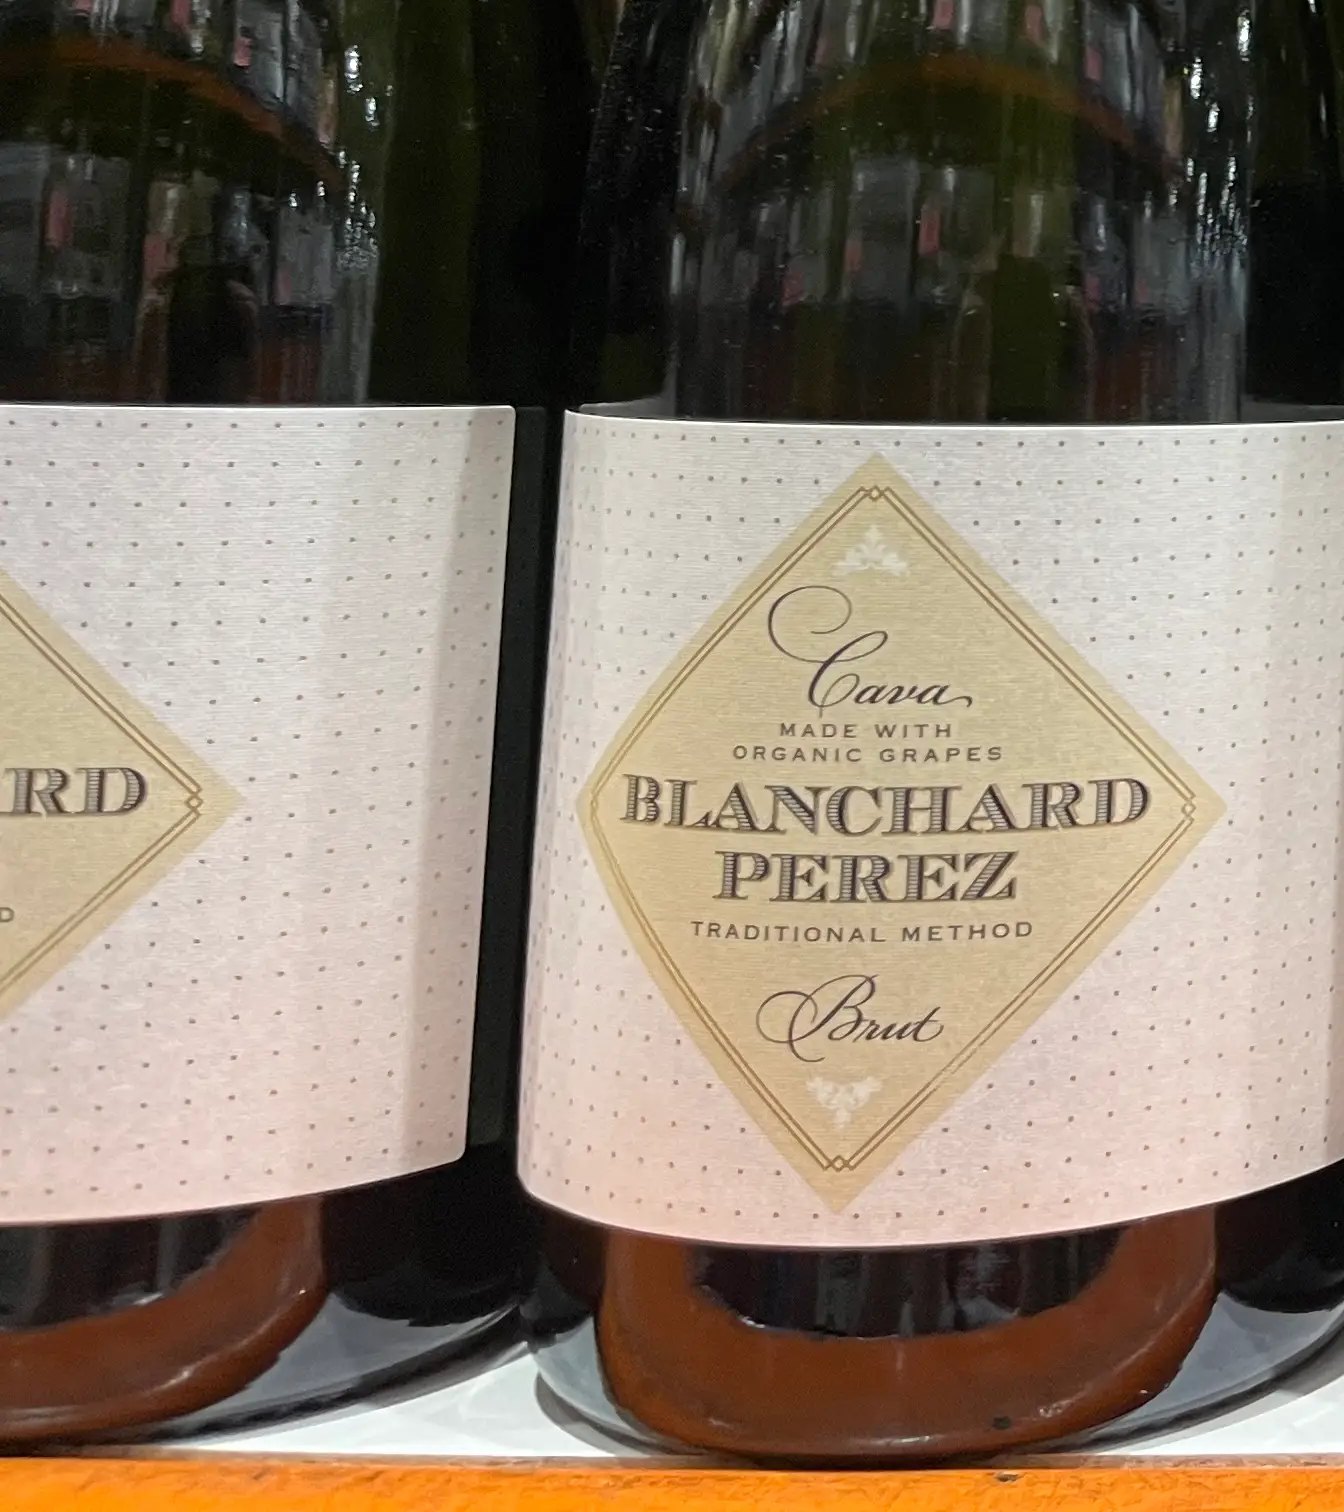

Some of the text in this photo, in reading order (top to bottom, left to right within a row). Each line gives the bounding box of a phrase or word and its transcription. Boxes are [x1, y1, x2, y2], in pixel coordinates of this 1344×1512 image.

[768, 585, 972, 718] Cava
[733, 745, 1002, 763] ORGANIC GRAPES
[779, 723, 952, 739] MADE WITH
[620, 773, 1151, 837] BLANCHARD
[712, 849, 1020, 903] PEREZ
[690, 920, 1033, 944] TRADITIONAL METHOD
[755, 974, 945, 1063] Brut
